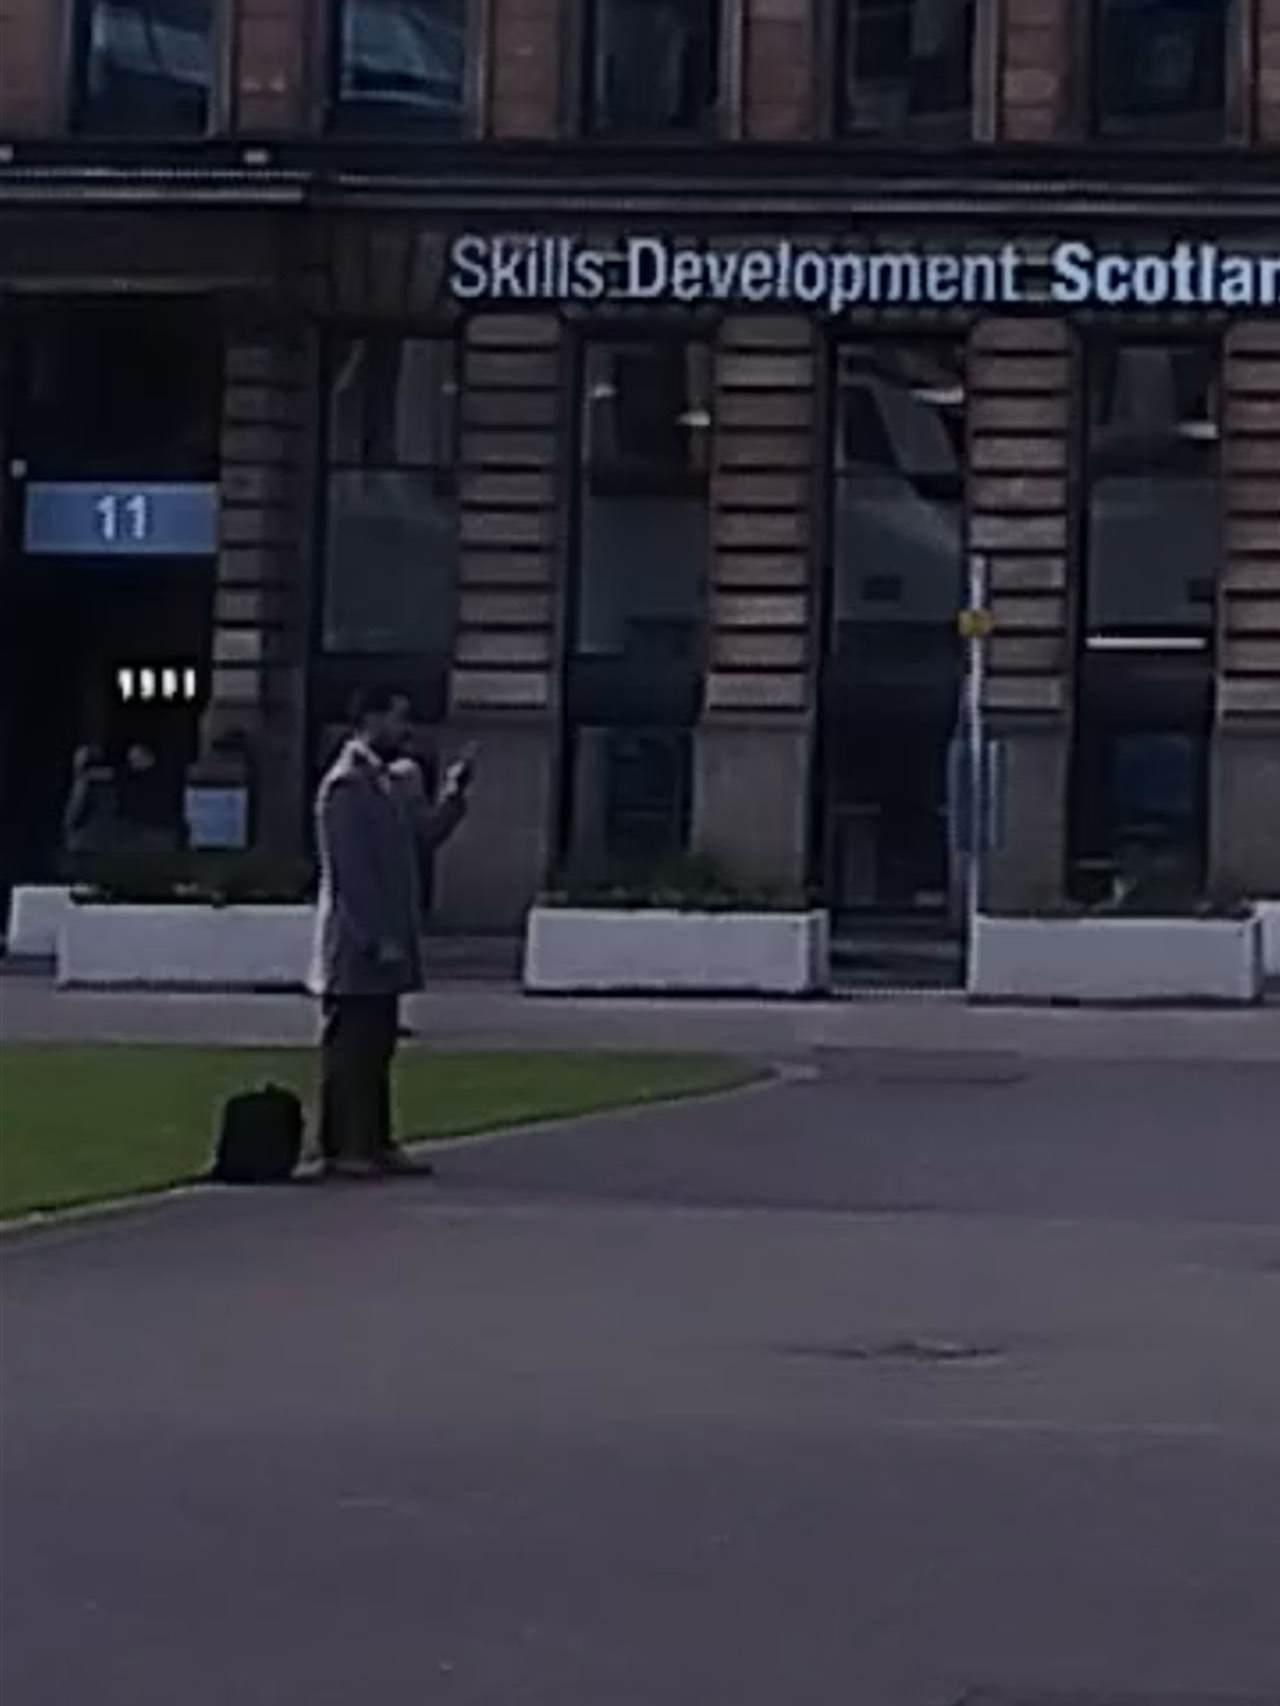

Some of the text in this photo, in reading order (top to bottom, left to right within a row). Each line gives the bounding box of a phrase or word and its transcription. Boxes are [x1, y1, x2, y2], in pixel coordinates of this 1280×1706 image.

[451, 235, 603, 299] Skills
[627, 238, 1022, 315] Development
[95, 494, 147, 540] 11
